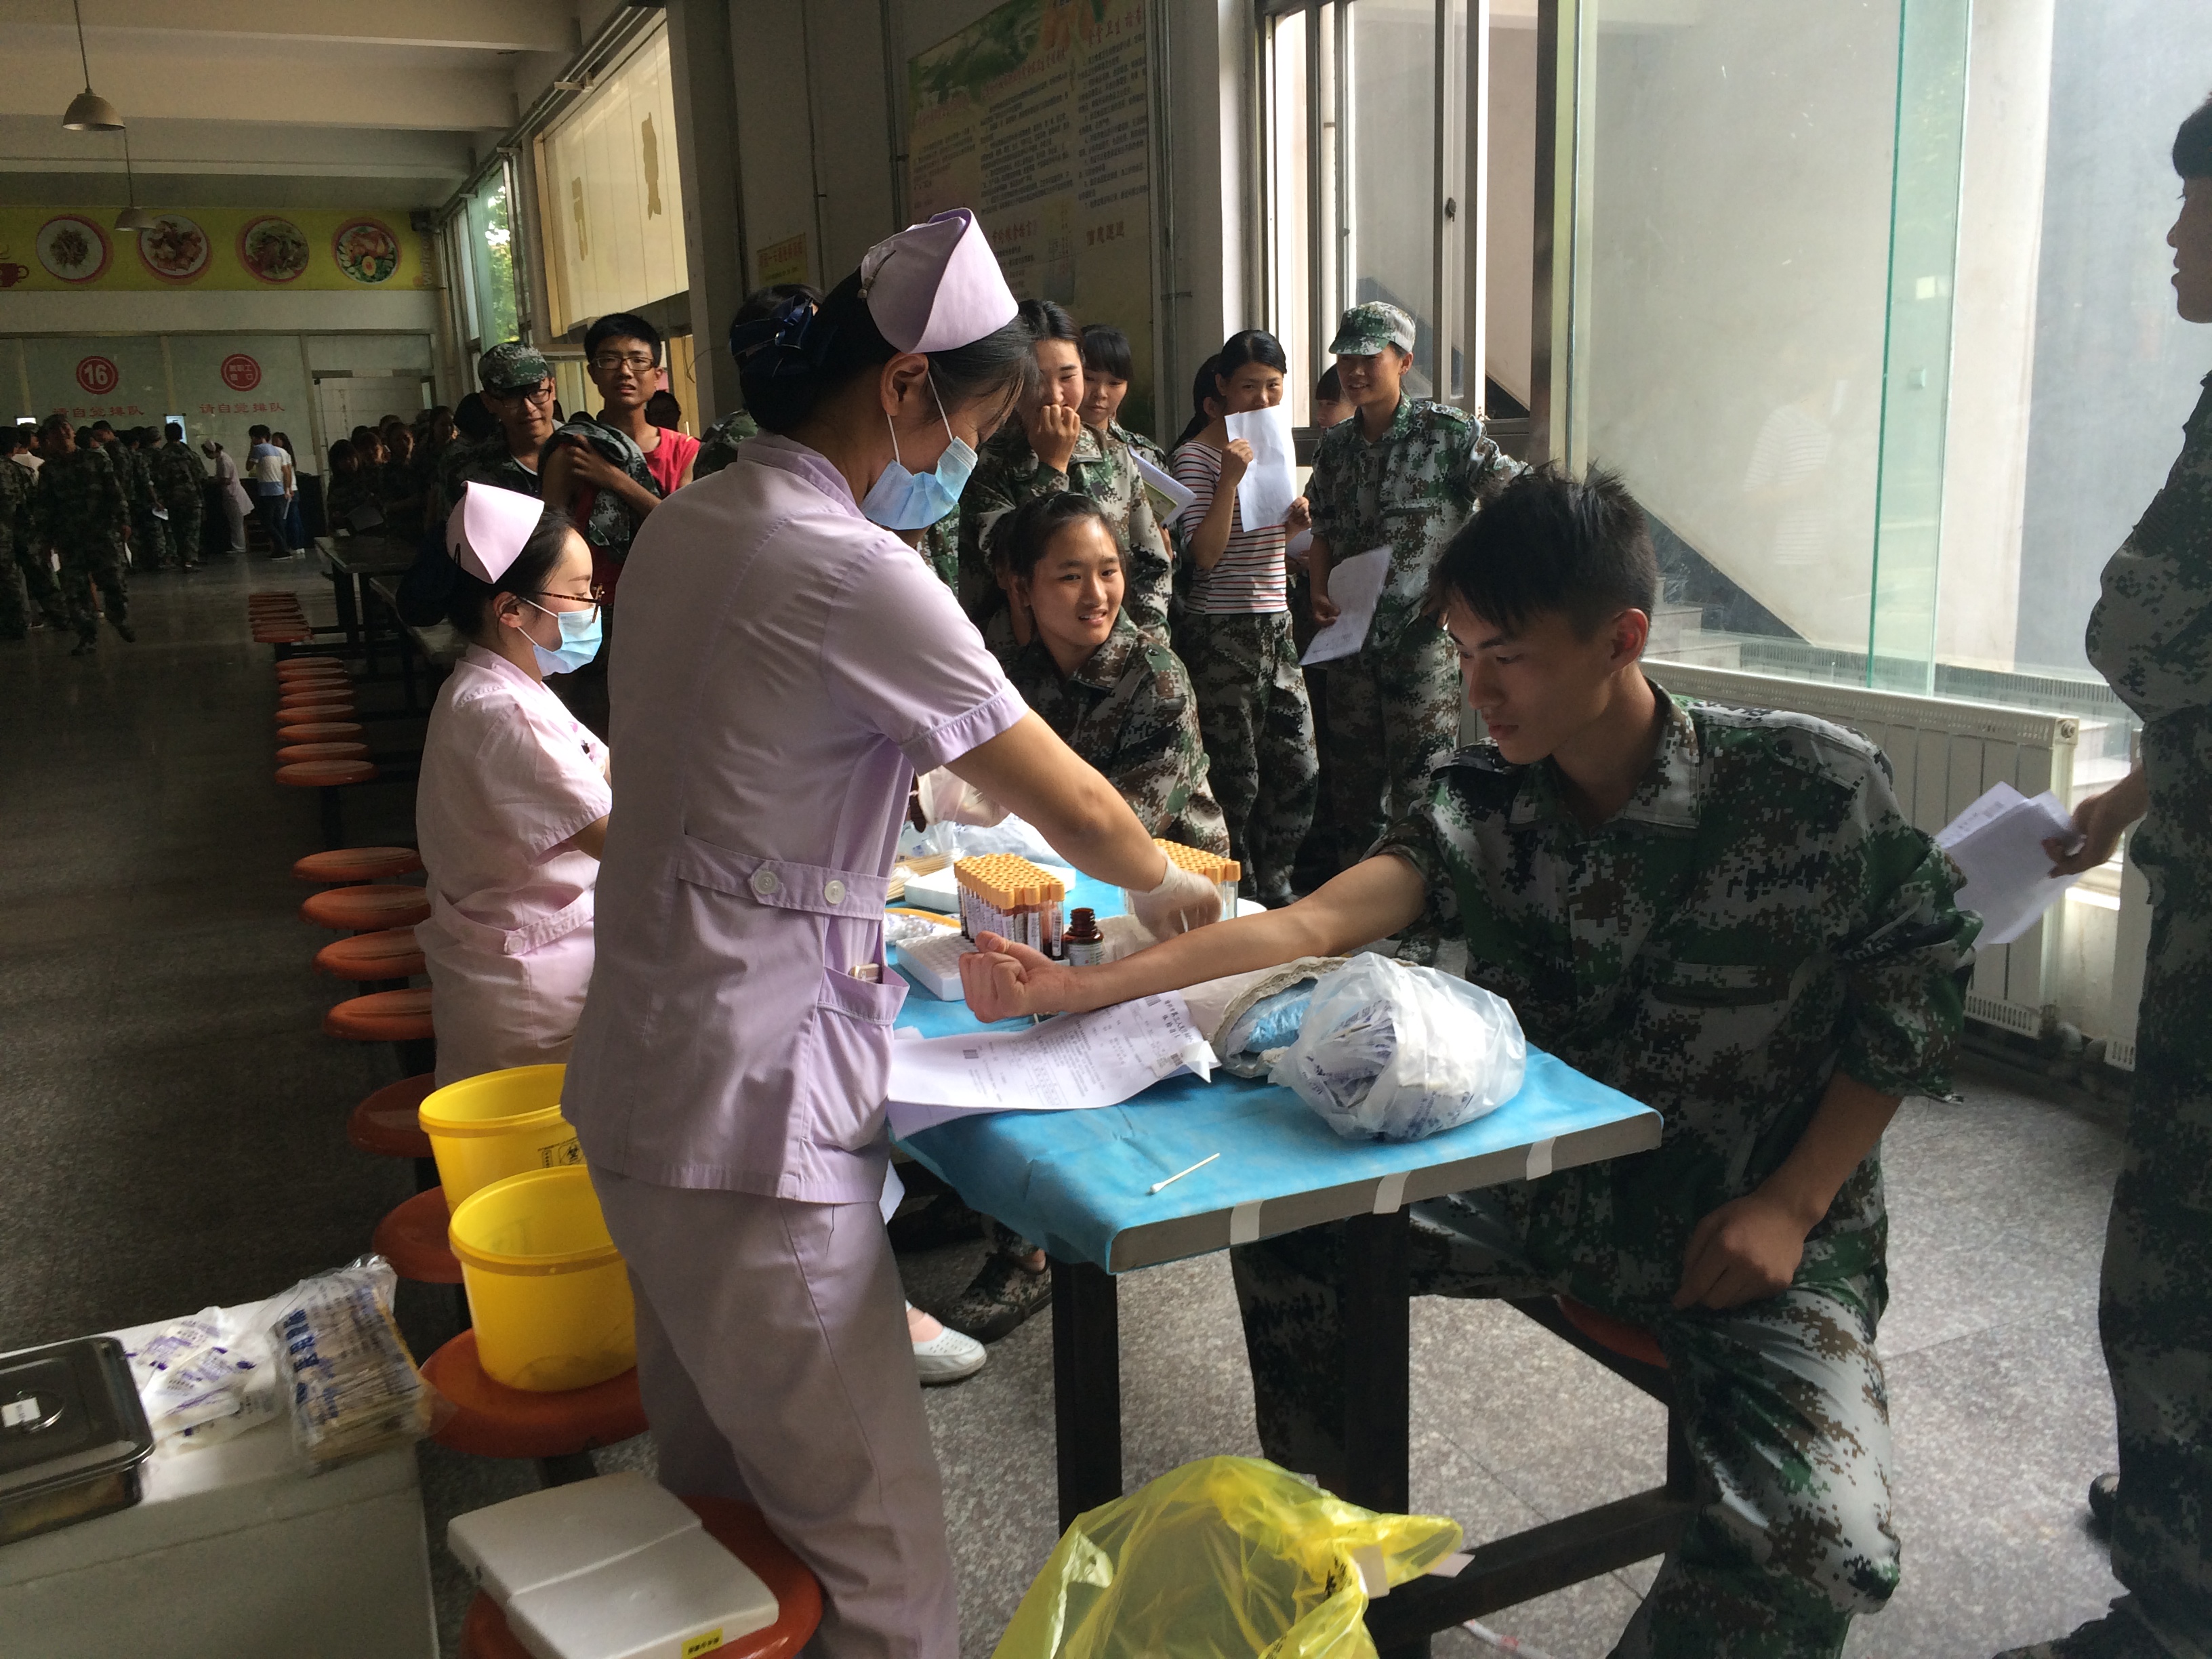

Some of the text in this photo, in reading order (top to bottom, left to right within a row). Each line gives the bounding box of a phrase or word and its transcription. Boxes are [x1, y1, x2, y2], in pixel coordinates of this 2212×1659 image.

[84, 364, 108, 385] 16
[52, 405, 145, 418] 请自觉排队
[199, 403, 285, 413] 请自觉排队
